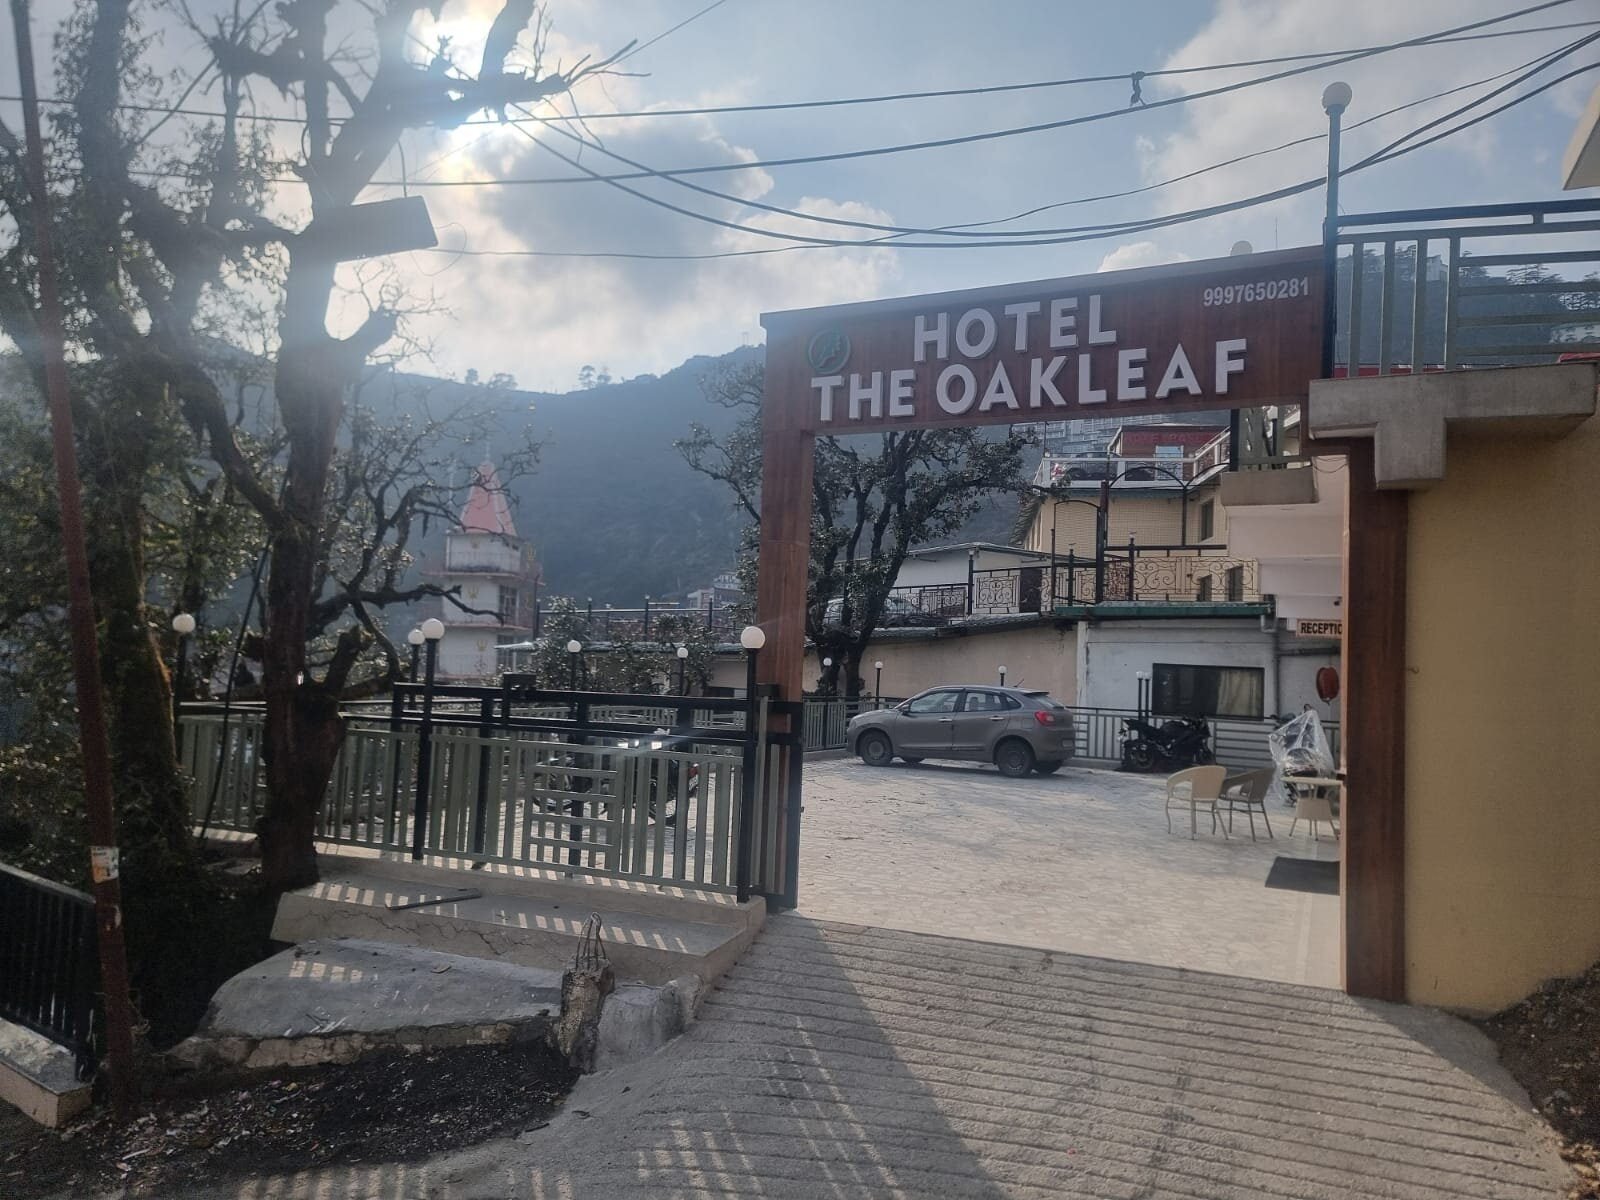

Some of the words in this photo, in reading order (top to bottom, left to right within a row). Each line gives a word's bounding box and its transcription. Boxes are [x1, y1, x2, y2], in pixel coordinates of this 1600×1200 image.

[1203, 276, 1309, 307] 9997650281
[913, 294, 1117, 362] HOTEL
[811, 368, 916, 421] THE
[936, 338, 1247, 415] OAKLEAF
[1300, 622, 1343, 635] RECEPTIO
